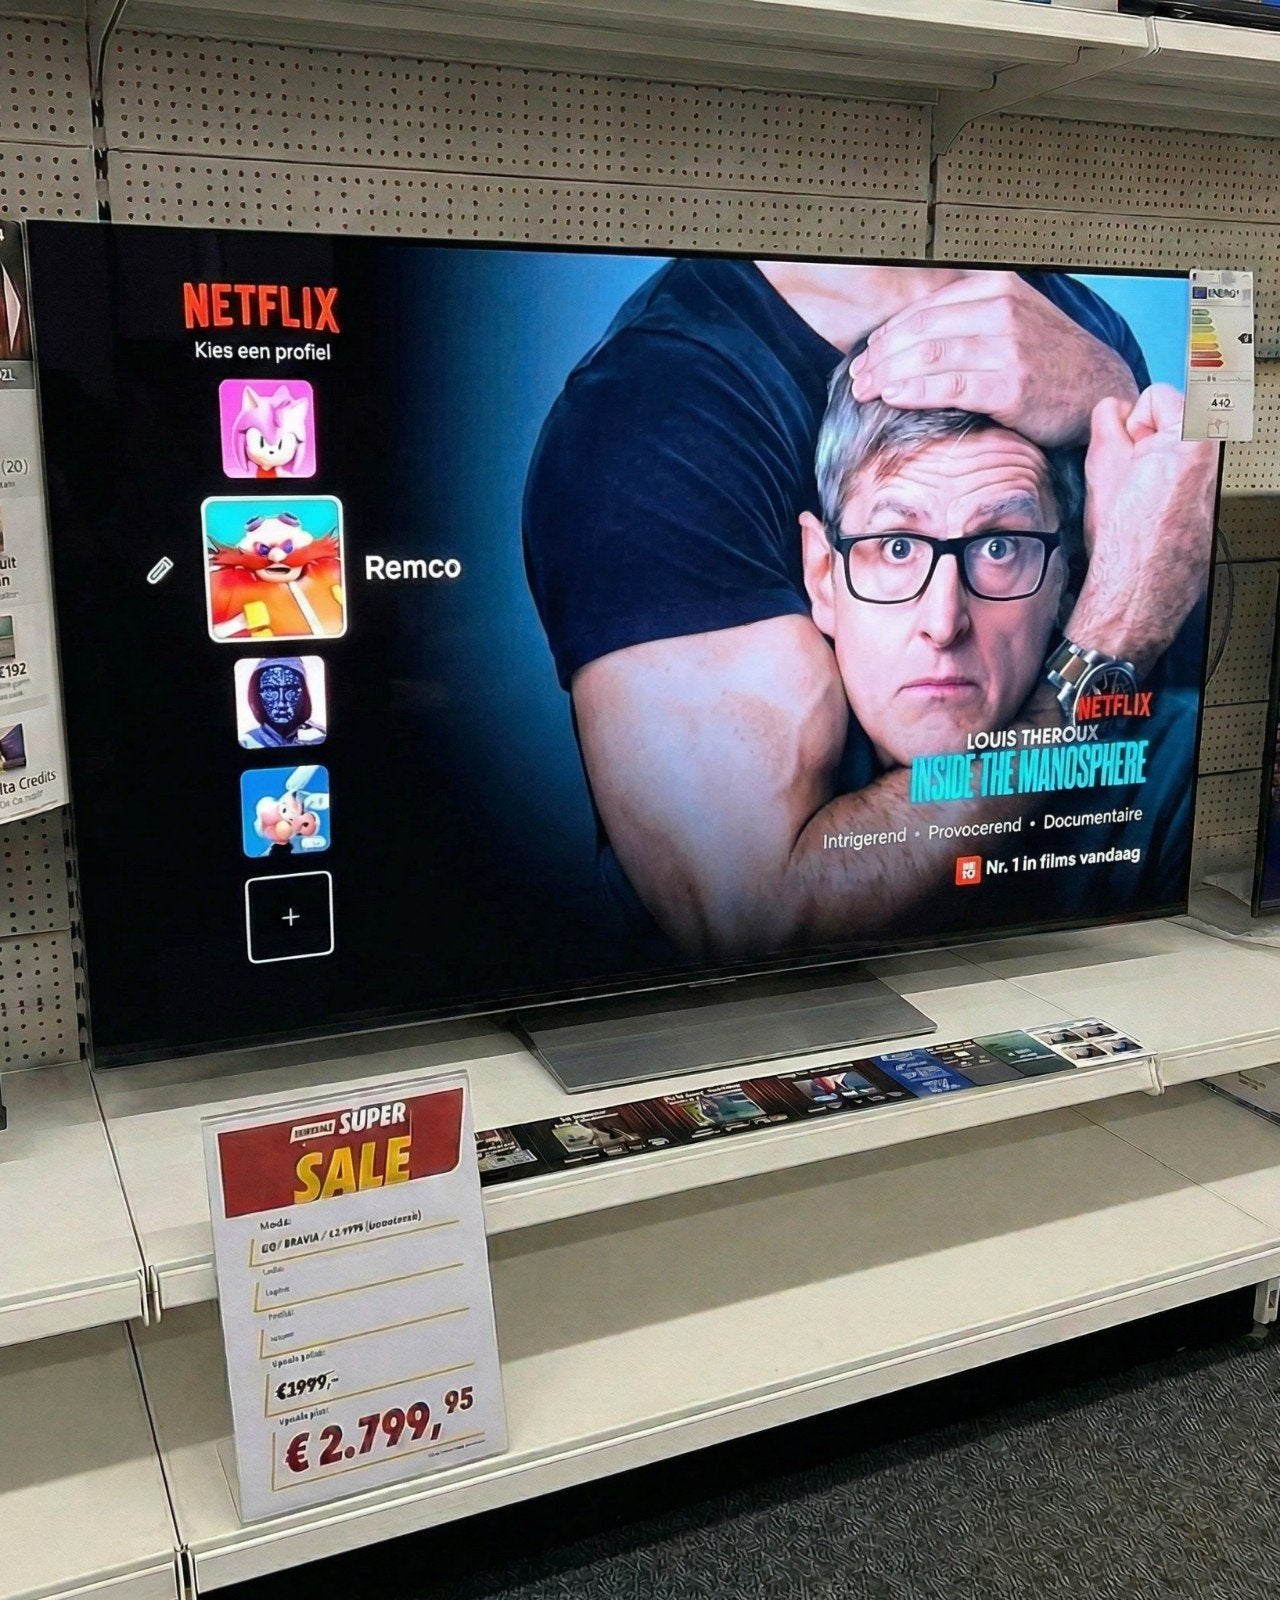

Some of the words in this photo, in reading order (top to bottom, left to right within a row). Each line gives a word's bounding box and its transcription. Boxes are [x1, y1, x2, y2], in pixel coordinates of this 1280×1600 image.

[183, 282, 340, 333] NETFLIX
[194, 341, 233, 359] Kies
[238, 345, 270, 359] een
[275, 343, 331, 363] profiel
[1, 459, 28, 476] (20)
[365, 555, 461, 580] Remco
[0, 662, 27, 678] €192
[1077, 691, 1153, 721] NETFLIX
[967, 729, 1017, 750] LOUIS
[1021, 724, 1099, 746] THEROUX
[19, 770, 56, 789] Credits
[910, 753, 976, 803] INSIDE
[980, 750, 1017, 797] THE
[1017, 740, 1149, 794] MANOSPHERE
[823, 827, 907, 850] Intrigerend
[929, 817, 1022, 840] Provocerend
[1044, 806, 1143, 830] Documentaire
[986, 860, 1008, 875] Nr.
[1022, 855, 1037, 871] in
[1040, 853, 1076, 869] films
[1079, 847, 1141, 864] vandaag
[338, 1102, 407, 1135] SUPER
[293, 1135, 412, 1204] SALE
[284, 1232, 319, 1248] BRAVIA
[285, 1431, 310, 1473] €
[318, 1401, 442, 1467] 2.799,
[443, 1385, 474, 1415] 95
